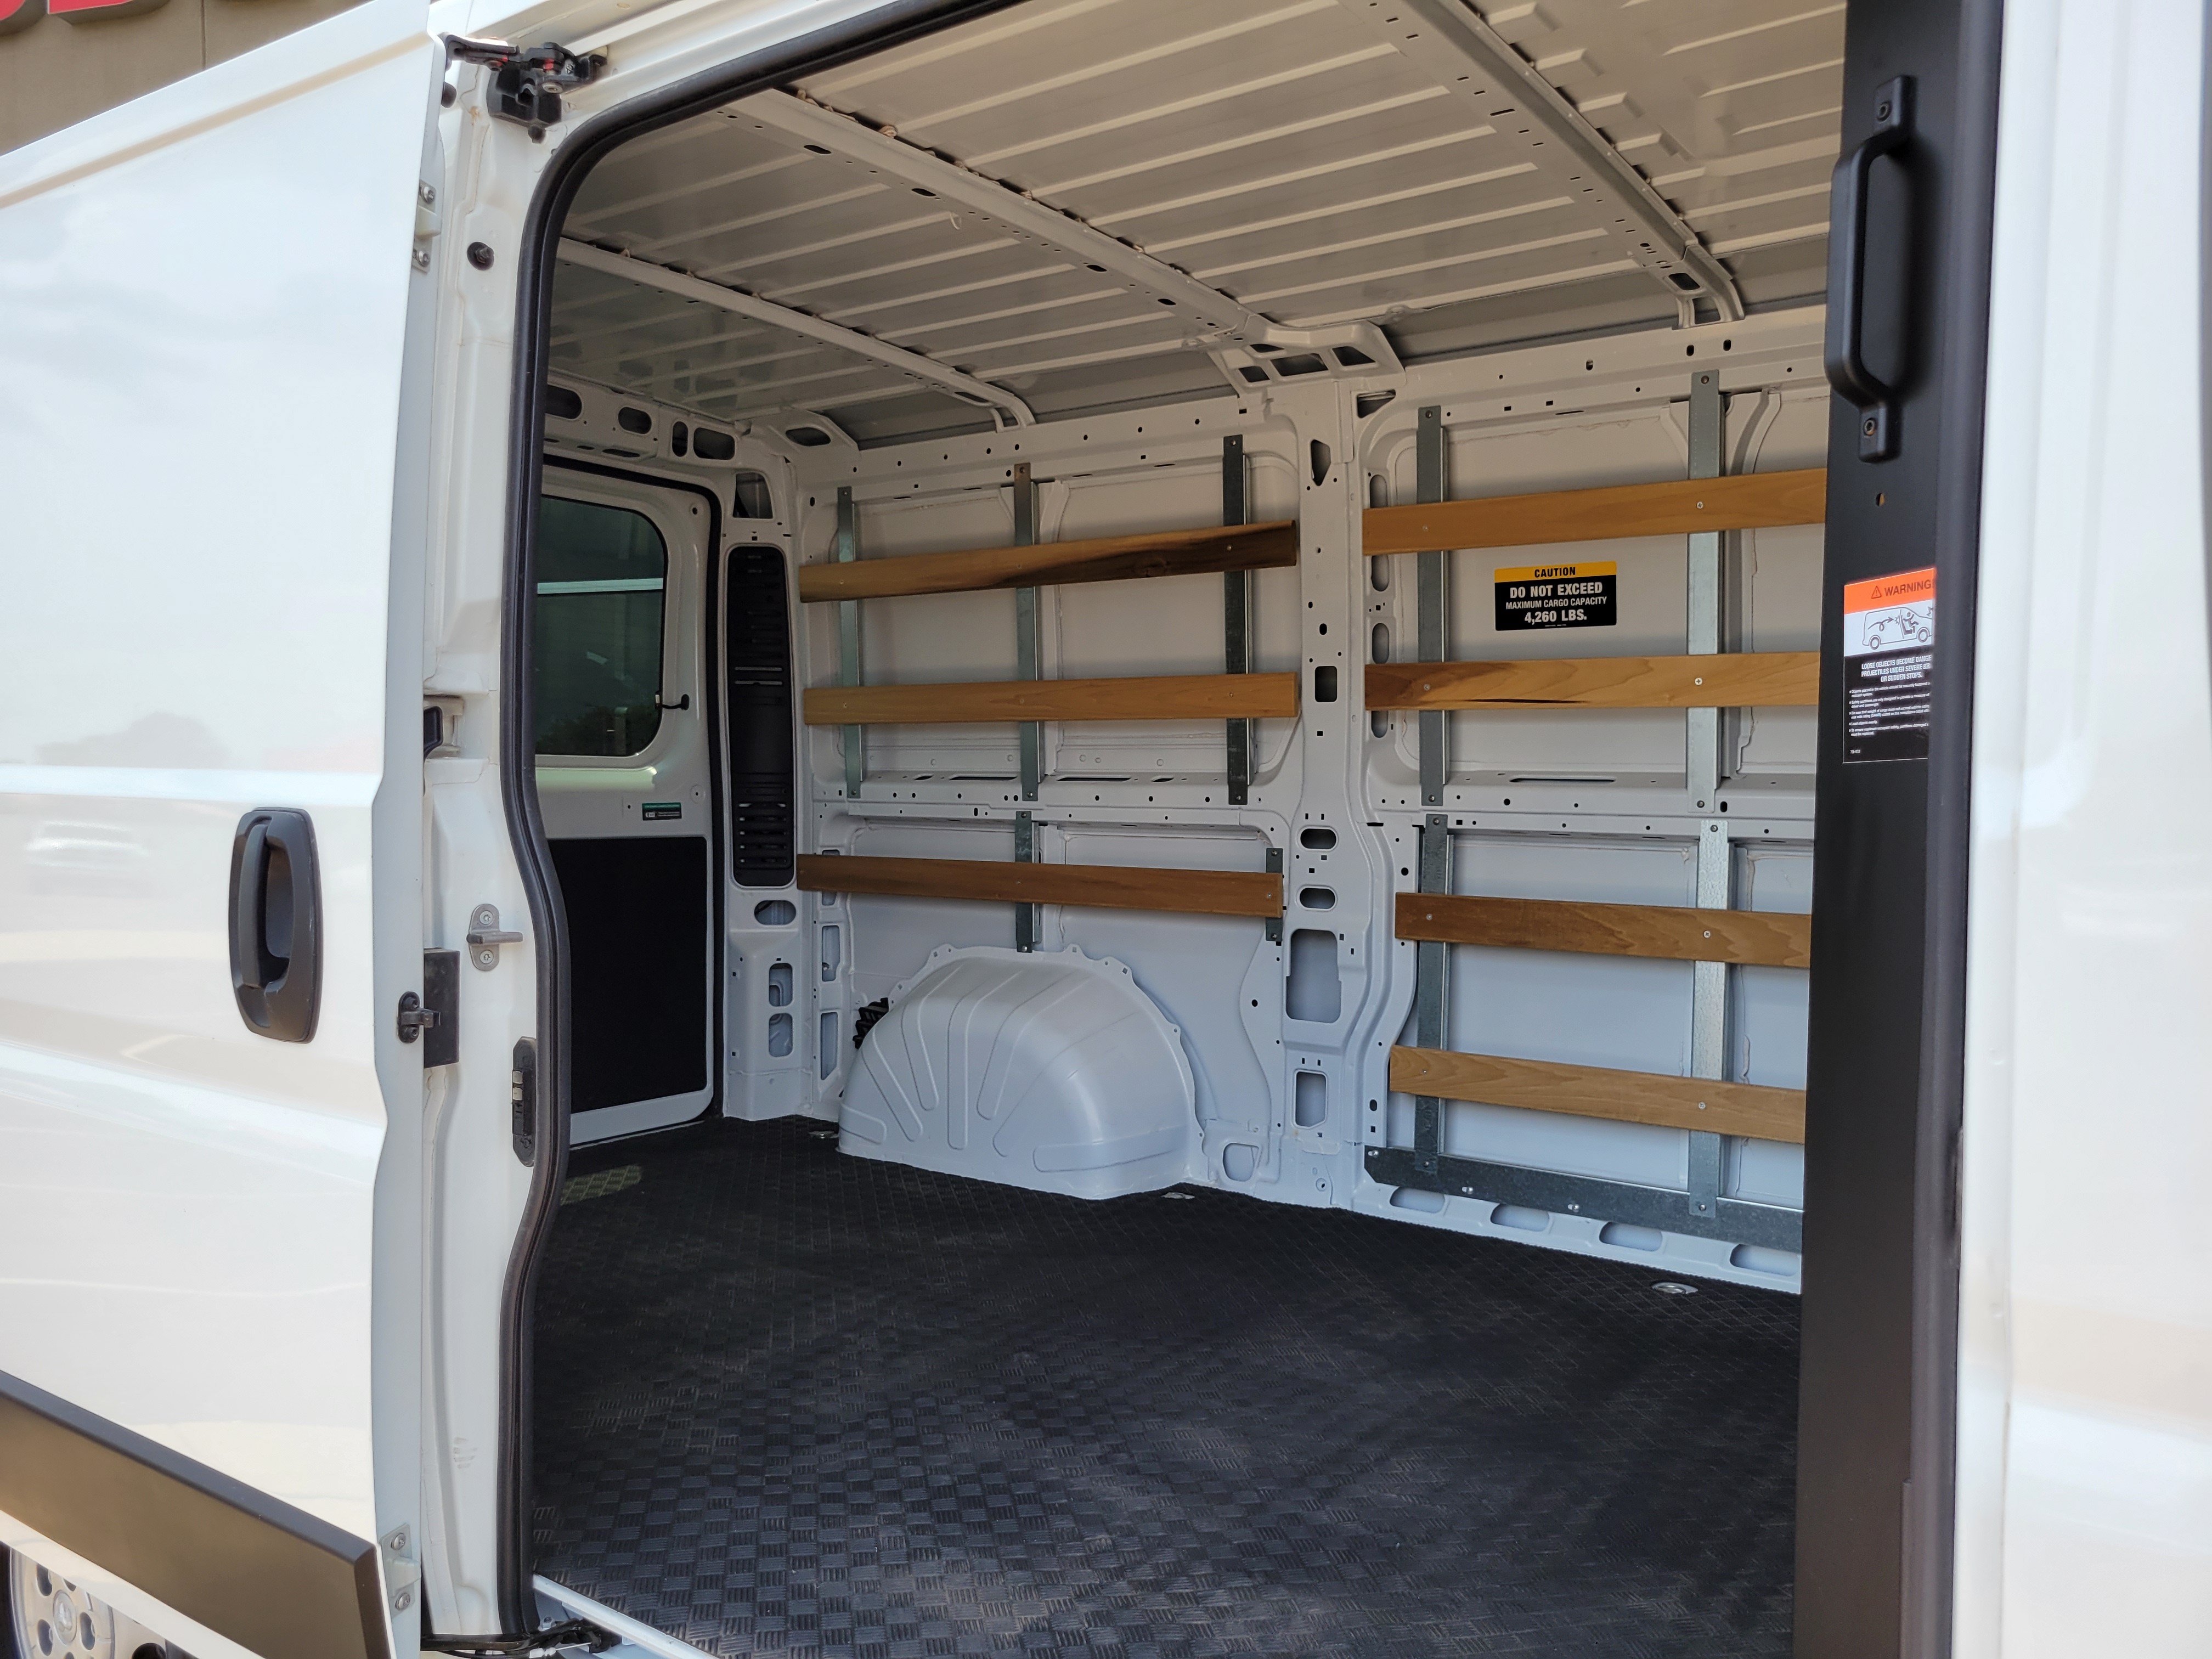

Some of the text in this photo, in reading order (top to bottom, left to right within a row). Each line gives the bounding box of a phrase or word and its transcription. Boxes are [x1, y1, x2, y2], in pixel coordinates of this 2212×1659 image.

[1534, 567, 1576, 578] CAUTION
[1510, 582, 1603, 599] DO NOT EXCEED
[1505, 596, 1607, 610] MAXIMUM CARGO CAPACITY
[1524, 609, 1587, 625] 4,260 LBS.
[1876, 660, 1895, 668] OBJECTS
[1896, 657, 1915, 665] BECOME
[1861, 668, 1889, 678] PROJECTILES
[1905, 664, 1923, 672] SEVERE
